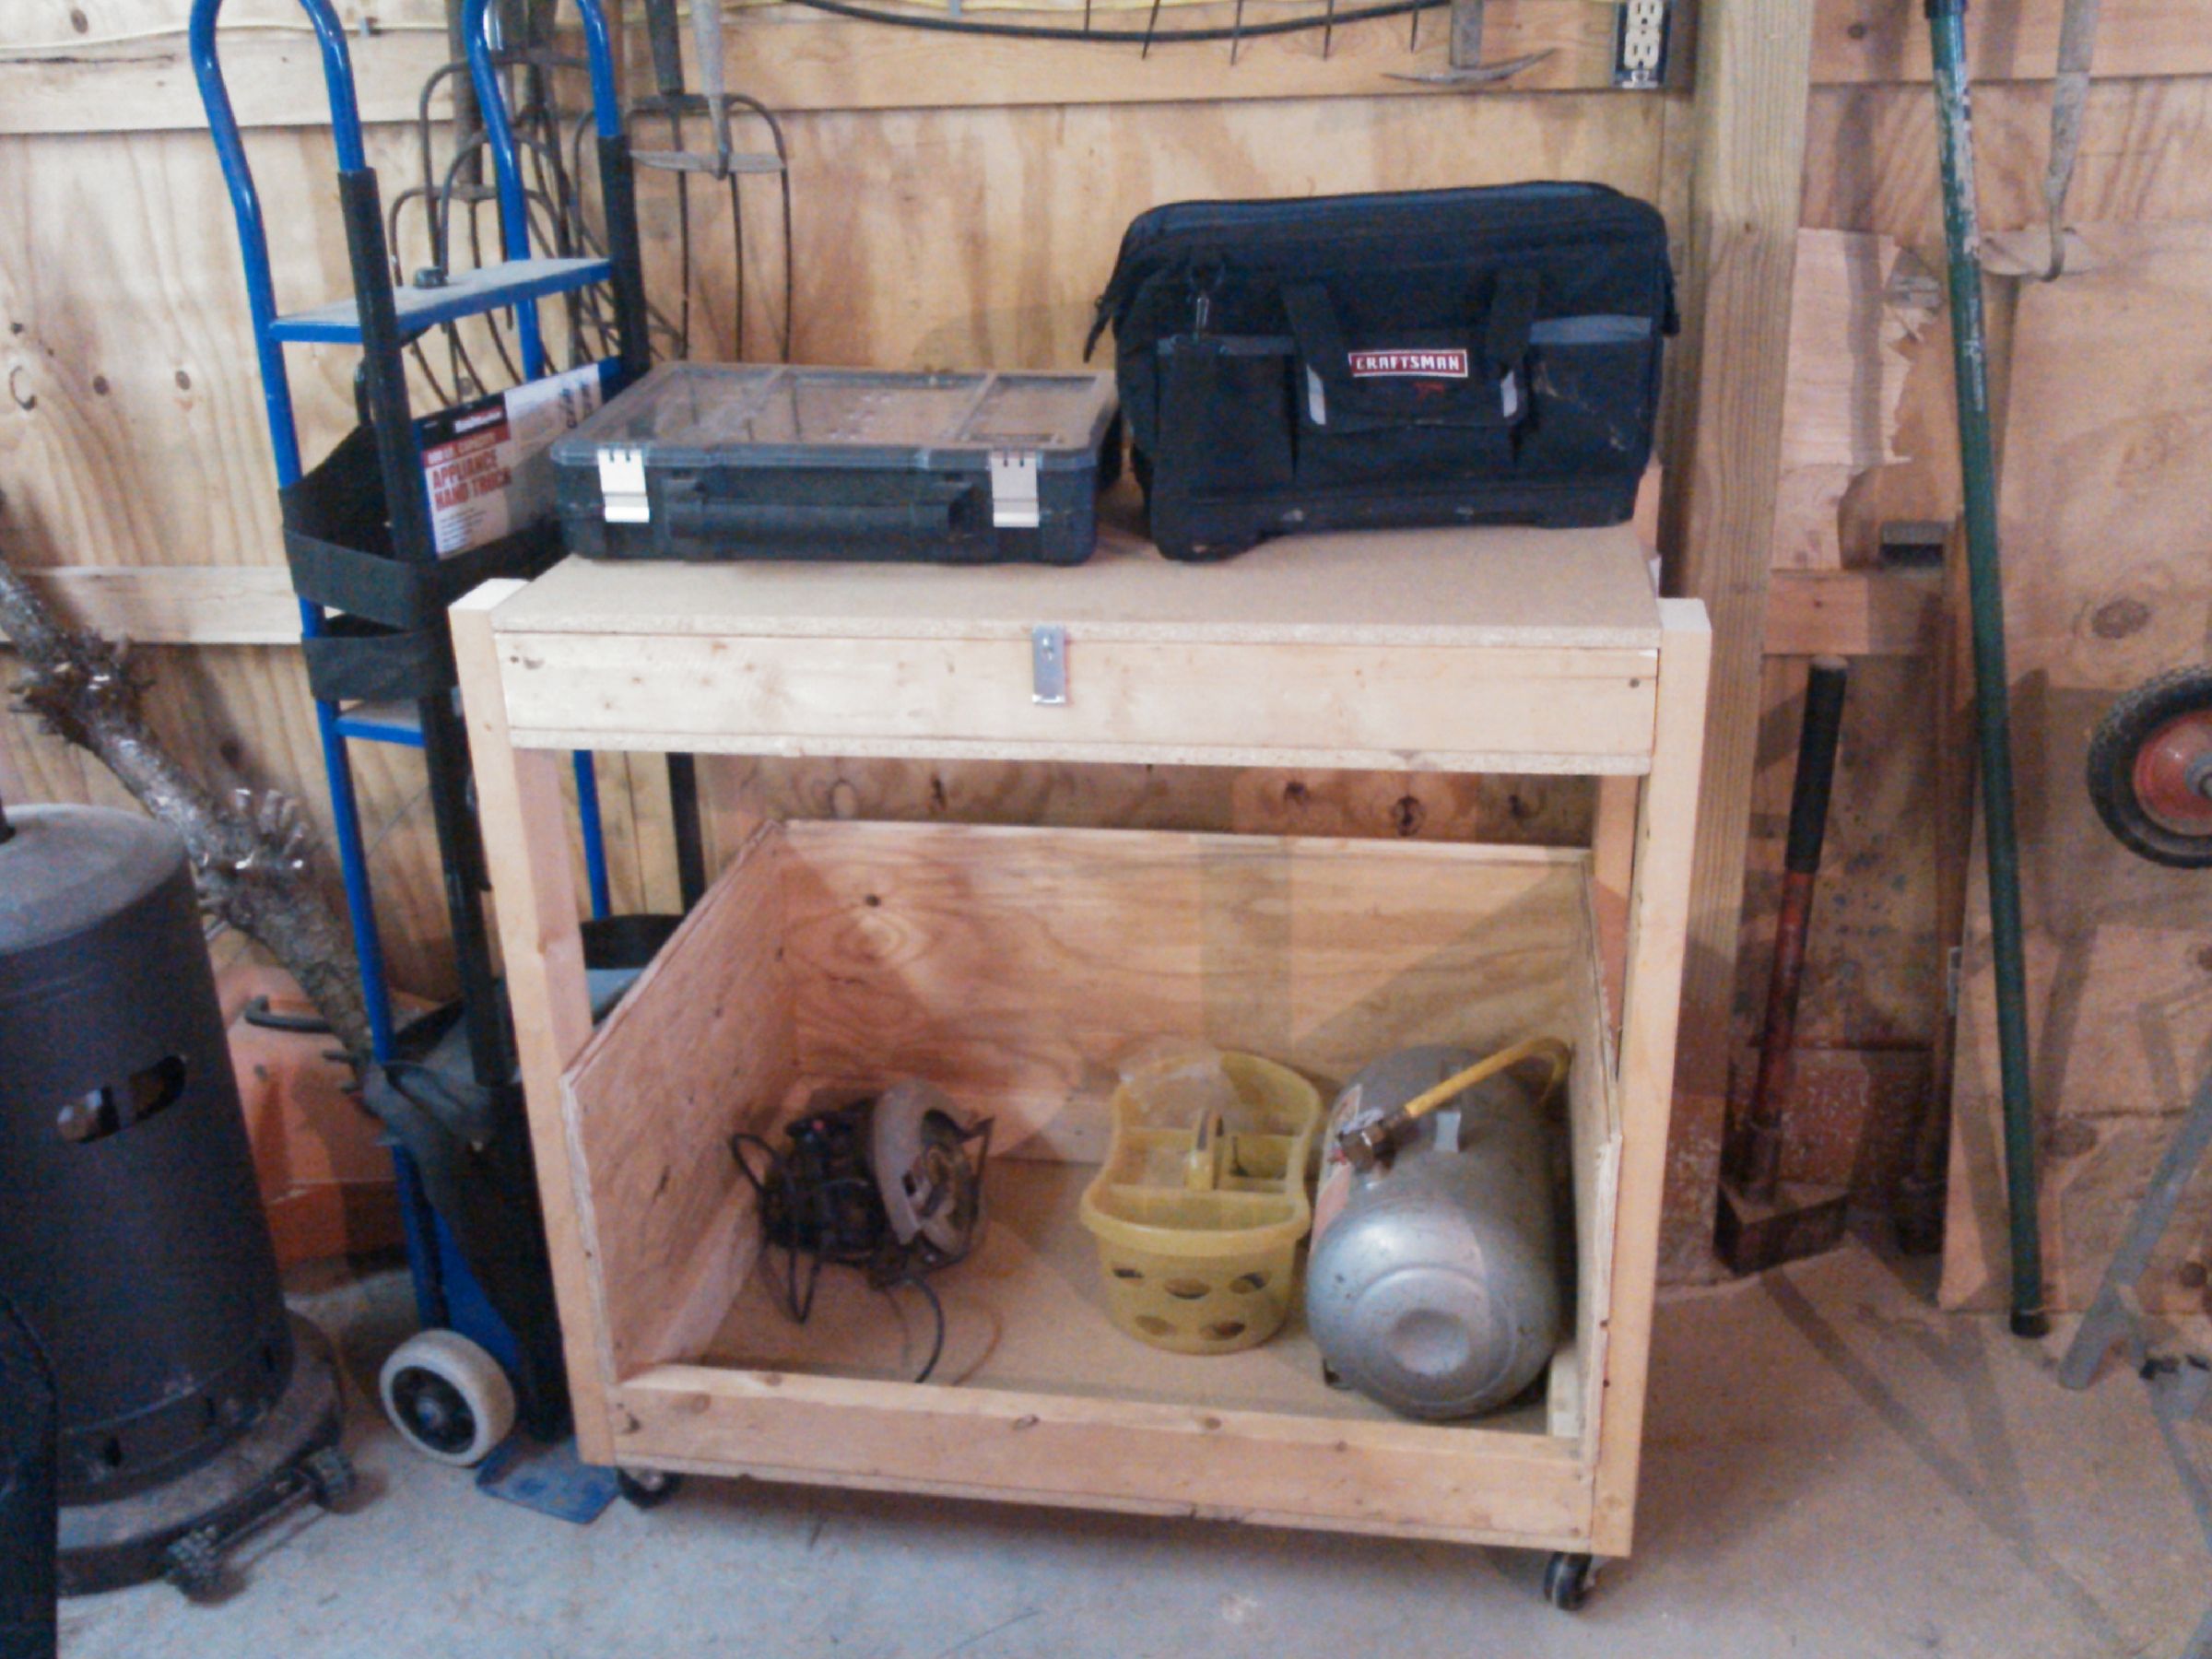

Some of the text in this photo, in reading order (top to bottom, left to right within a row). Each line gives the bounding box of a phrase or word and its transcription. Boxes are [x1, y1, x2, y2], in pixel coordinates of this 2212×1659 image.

[1356, 355, 1460, 371] CRAFTSMAN
[433, 449, 498, 488] APPLIANCE
[434, 467, 512, 512] HAND TRUCK
